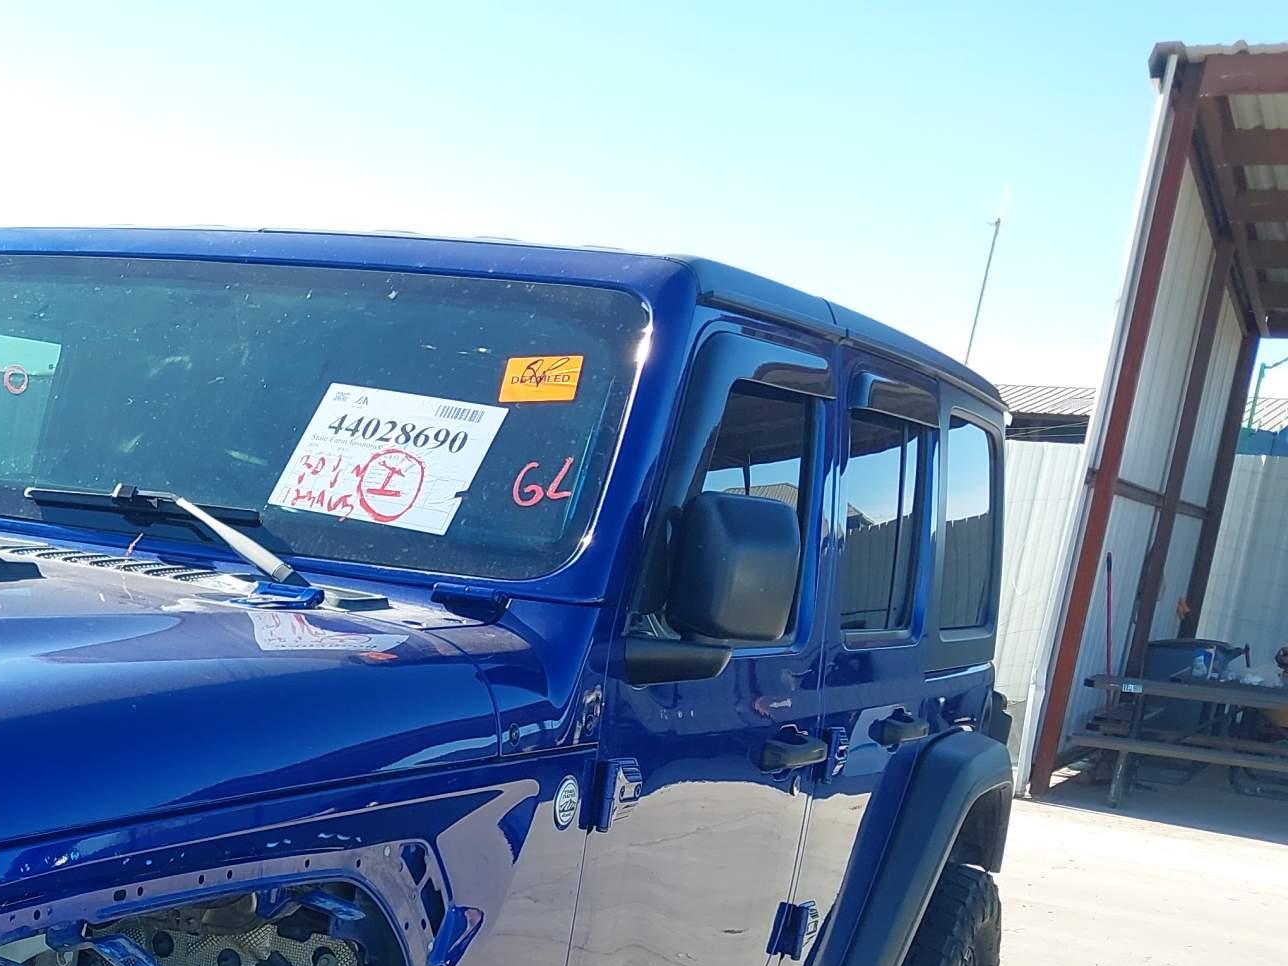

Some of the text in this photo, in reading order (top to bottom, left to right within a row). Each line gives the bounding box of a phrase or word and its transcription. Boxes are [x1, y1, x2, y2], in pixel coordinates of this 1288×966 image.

[311, 433, 331, 444] State
[330, 436, 348, 447] Farm
[328, 412, 469, 454] 44028690
